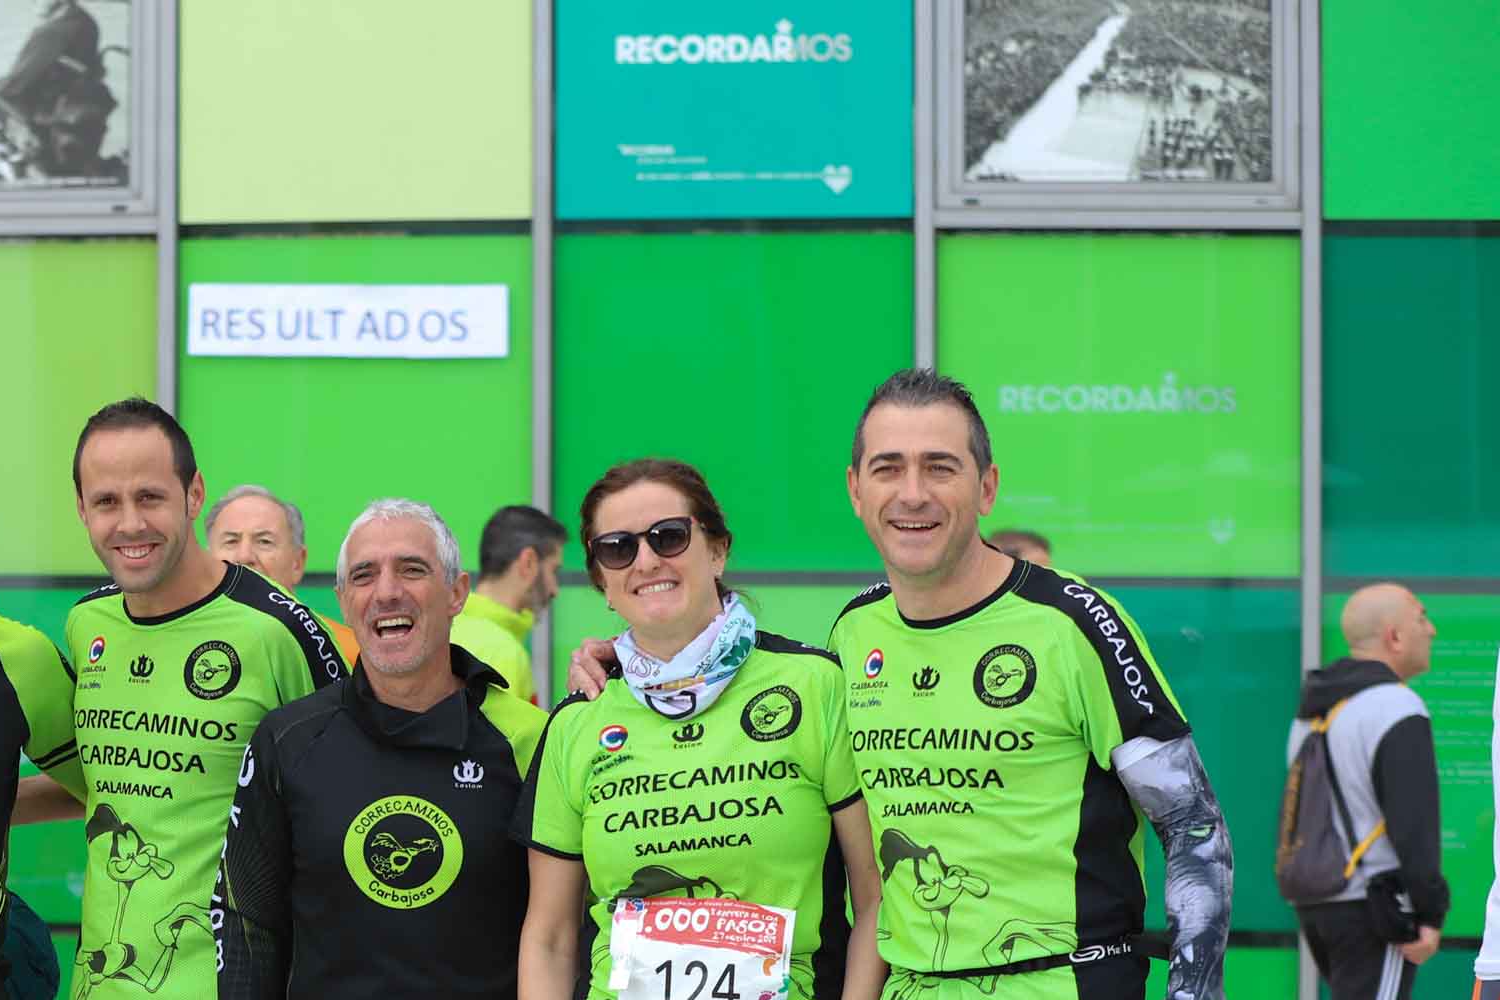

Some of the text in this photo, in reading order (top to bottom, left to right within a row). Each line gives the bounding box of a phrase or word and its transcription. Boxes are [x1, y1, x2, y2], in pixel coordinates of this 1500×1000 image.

[201, 308, 469, 342] RESULTADOS
[268, 591, 341, 684] CARBAJO
[850, 728, 1035, 752] ORRECAMINOS
[80, 744, 206, 774] CARBAJOSA
[96, 780, 174, 800] SALAMANCA
[589, 760, 801, 804] CORRECAMINOS
[861, 766, 1005, 790] CARBAJOSA
[355, 800, 453, 838] CORRECAMINOS
[603, 796, 784, 833] CARBAJOSA
[882, 801, 975, 818] SALAMANCA
[635, 834, 752, 856] SALAMANCA
[368, 880, 435, 907] Carbajosa
[716, 918, 777, 935] PASOS
